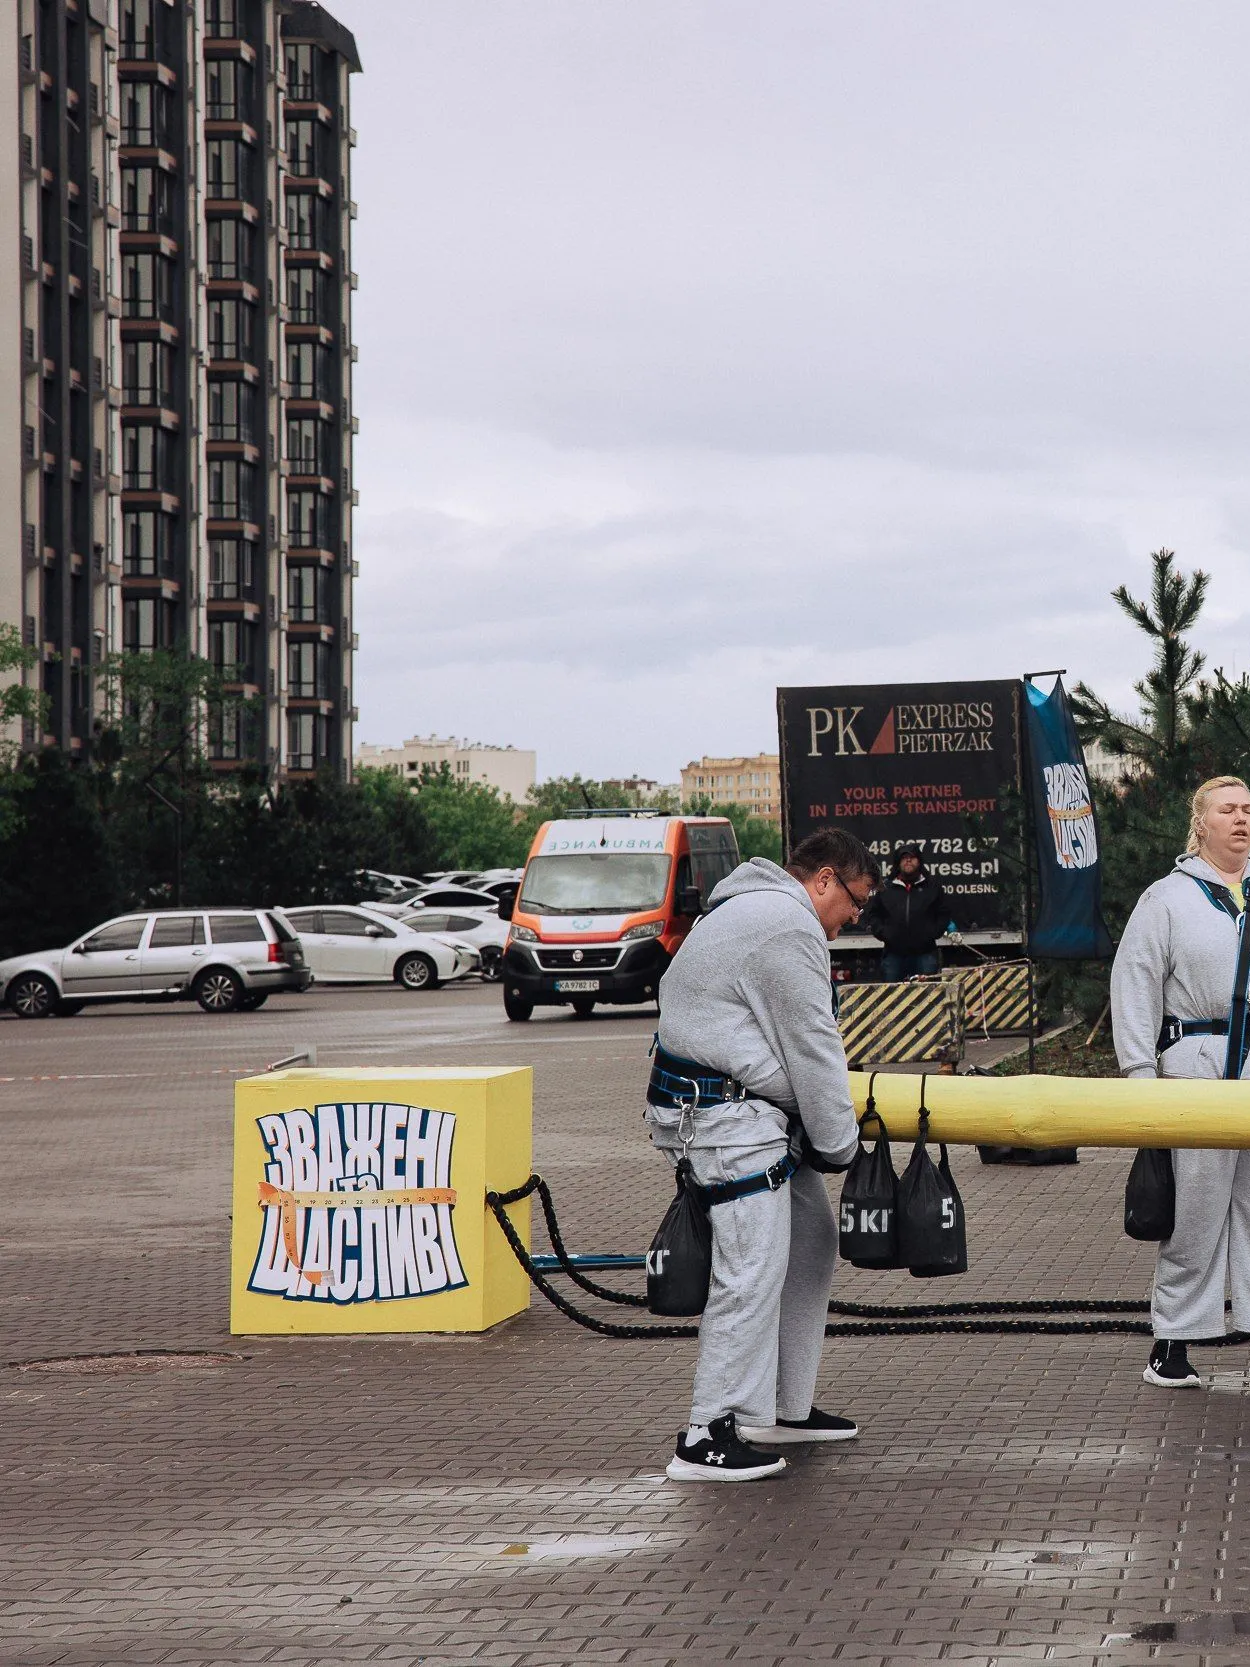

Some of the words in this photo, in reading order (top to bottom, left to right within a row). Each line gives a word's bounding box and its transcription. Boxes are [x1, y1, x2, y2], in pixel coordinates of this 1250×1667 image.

[897, 702, 994, 730] EXPRESS
[806, 706, 868, 757] PK
[898, 731, 994, 754] PIETRZAK
[843, 787, 886, 800] YOUR
[893, 784, 962, 799] PARTNER
[809, 804, 827, 817] IN
[835, 802, 898, 816] EXPRESS
[905, 799, 996, 814] TRANSPORT
[931, 838, 963, 854] 782
[255, 1103, 456, 1192] ЗВАЖЕНІ
[841, 1203, 855, 1232] 5
[942, 1198, 954, 1229] 5
[247, 1204, 469, 1304] ЩАСЛИВІ
